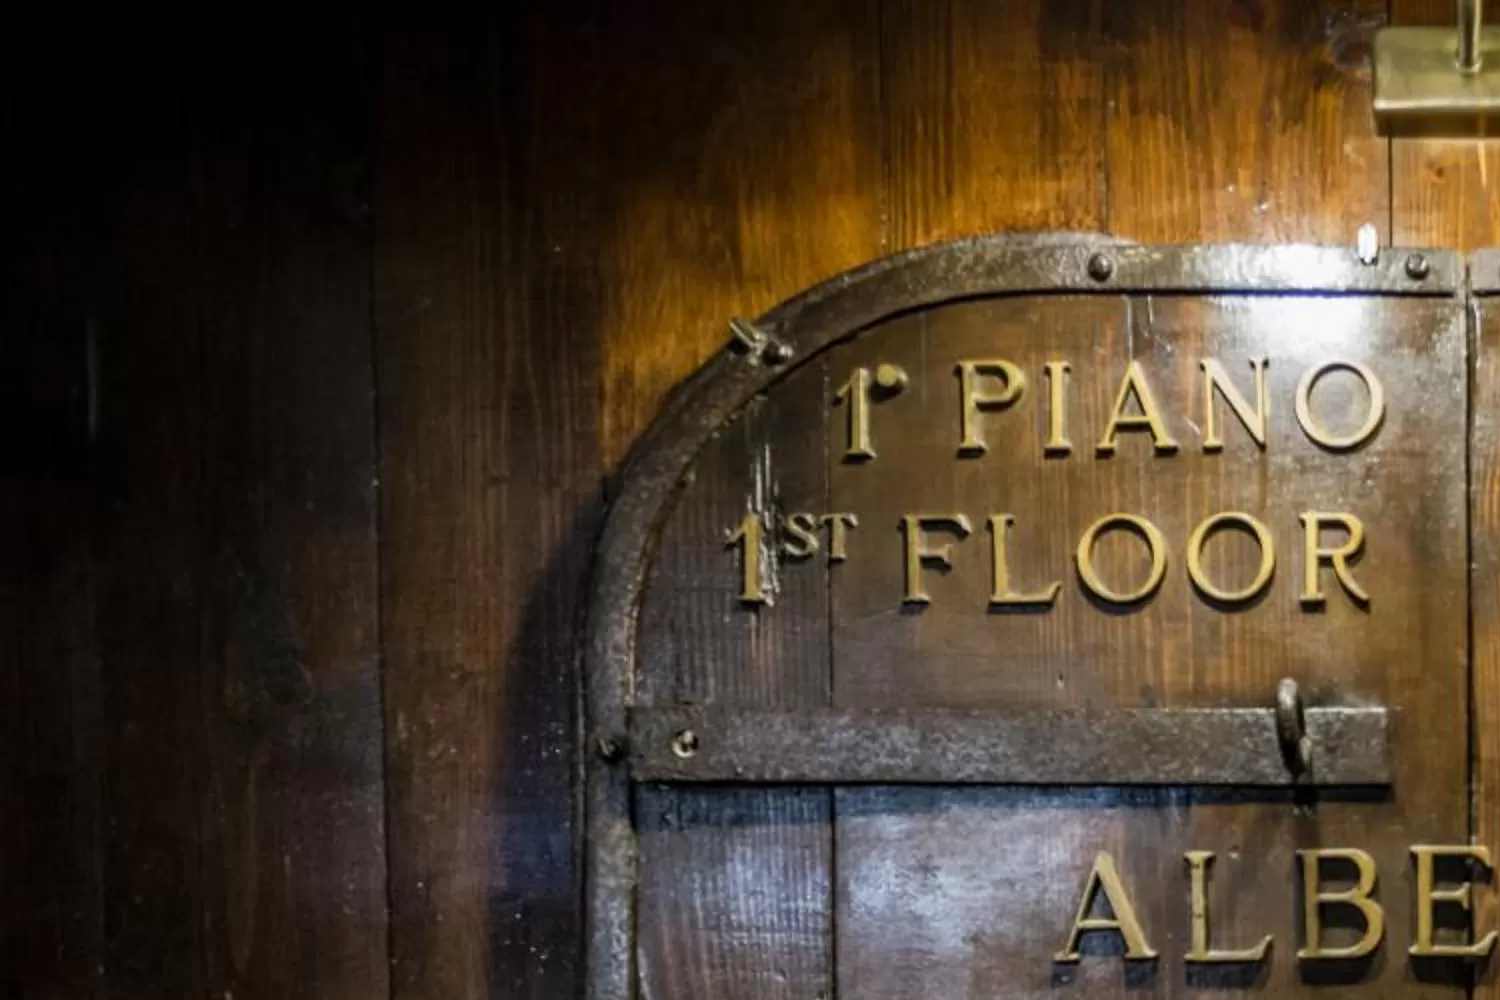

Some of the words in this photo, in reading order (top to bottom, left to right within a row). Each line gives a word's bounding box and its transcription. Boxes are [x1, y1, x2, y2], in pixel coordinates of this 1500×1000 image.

[955, 356, 1386, 455] PIANO
[725, 511, 857, 605] 1ST
[900, 510, 1369, 605] FLOOR
